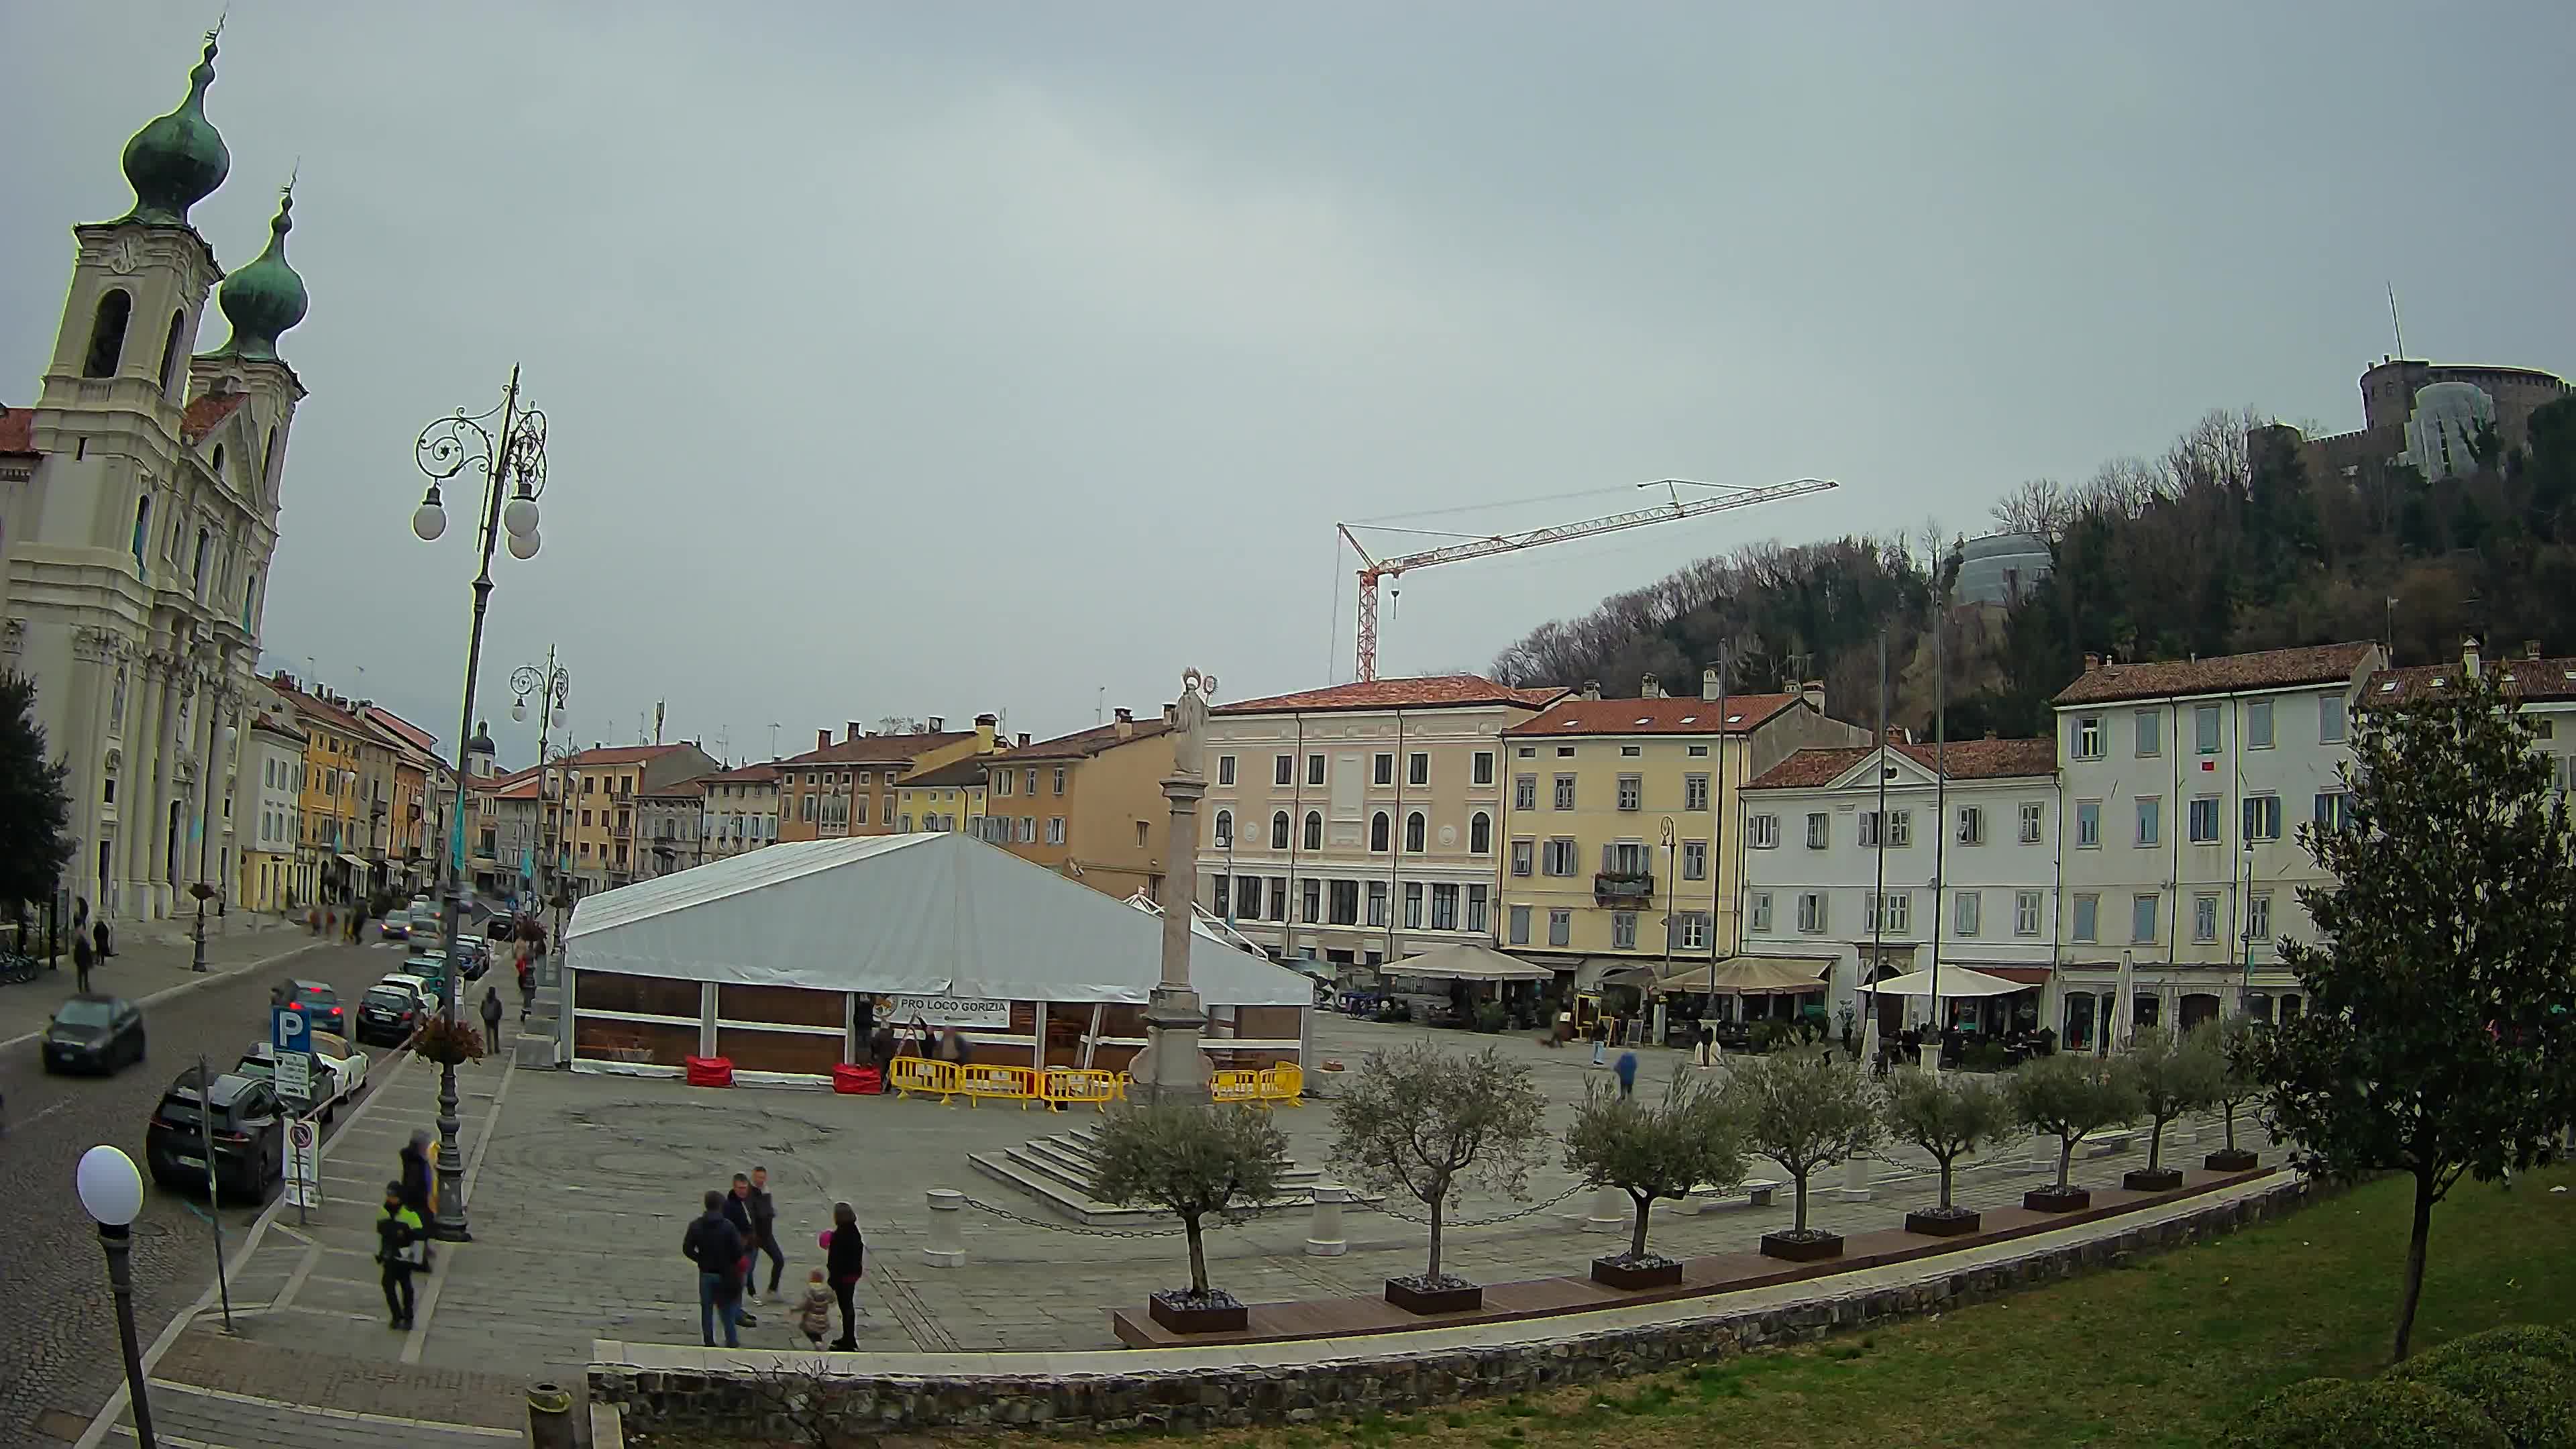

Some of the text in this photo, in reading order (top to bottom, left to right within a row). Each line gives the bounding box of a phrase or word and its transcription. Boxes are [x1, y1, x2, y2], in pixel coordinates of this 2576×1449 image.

[901, 998, 1007, 1012] PRO LOCO GORIZIA
[279, 1011, 304, 1047] P
